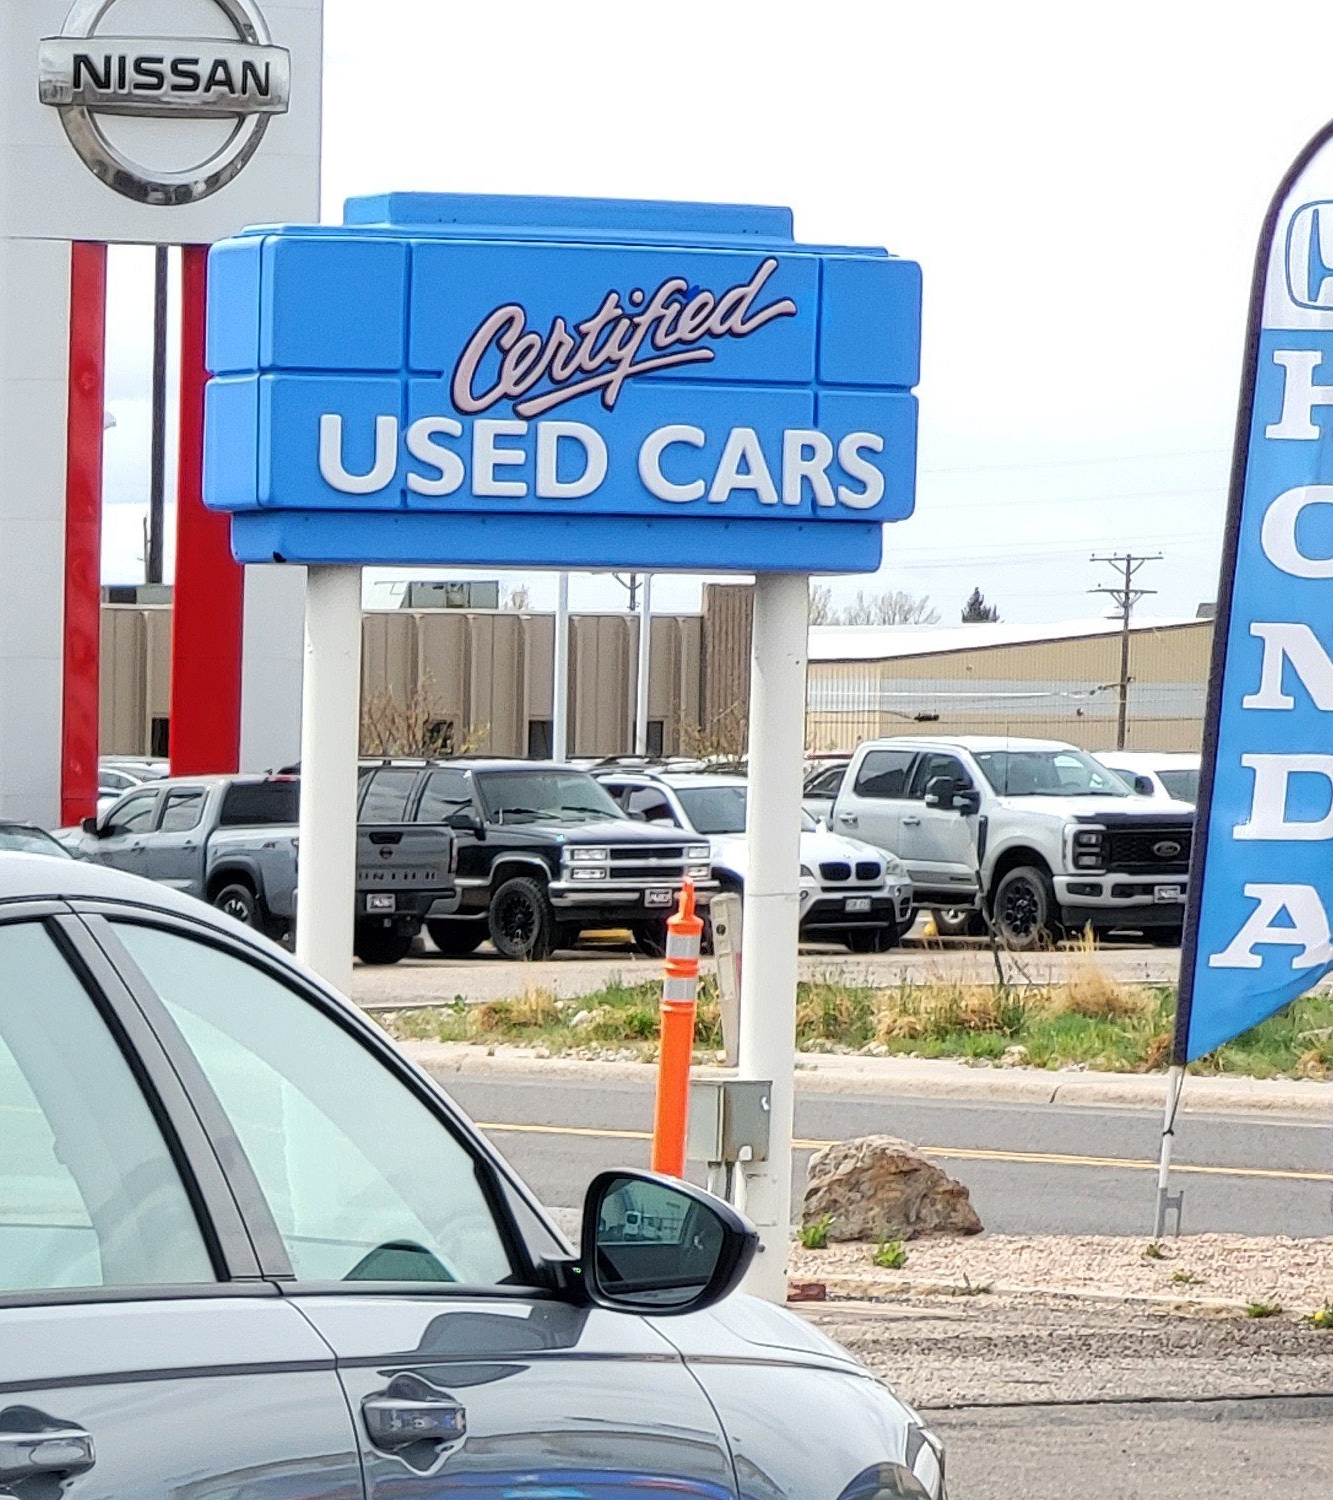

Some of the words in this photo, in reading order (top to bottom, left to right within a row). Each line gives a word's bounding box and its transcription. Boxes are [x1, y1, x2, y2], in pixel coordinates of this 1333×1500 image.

[72, 53, 271, 97] NISSAN
[451, 257, 798, 417] Certified
[318, 414, 609, 500] USED
[637, 424, 887, 510] CARS
